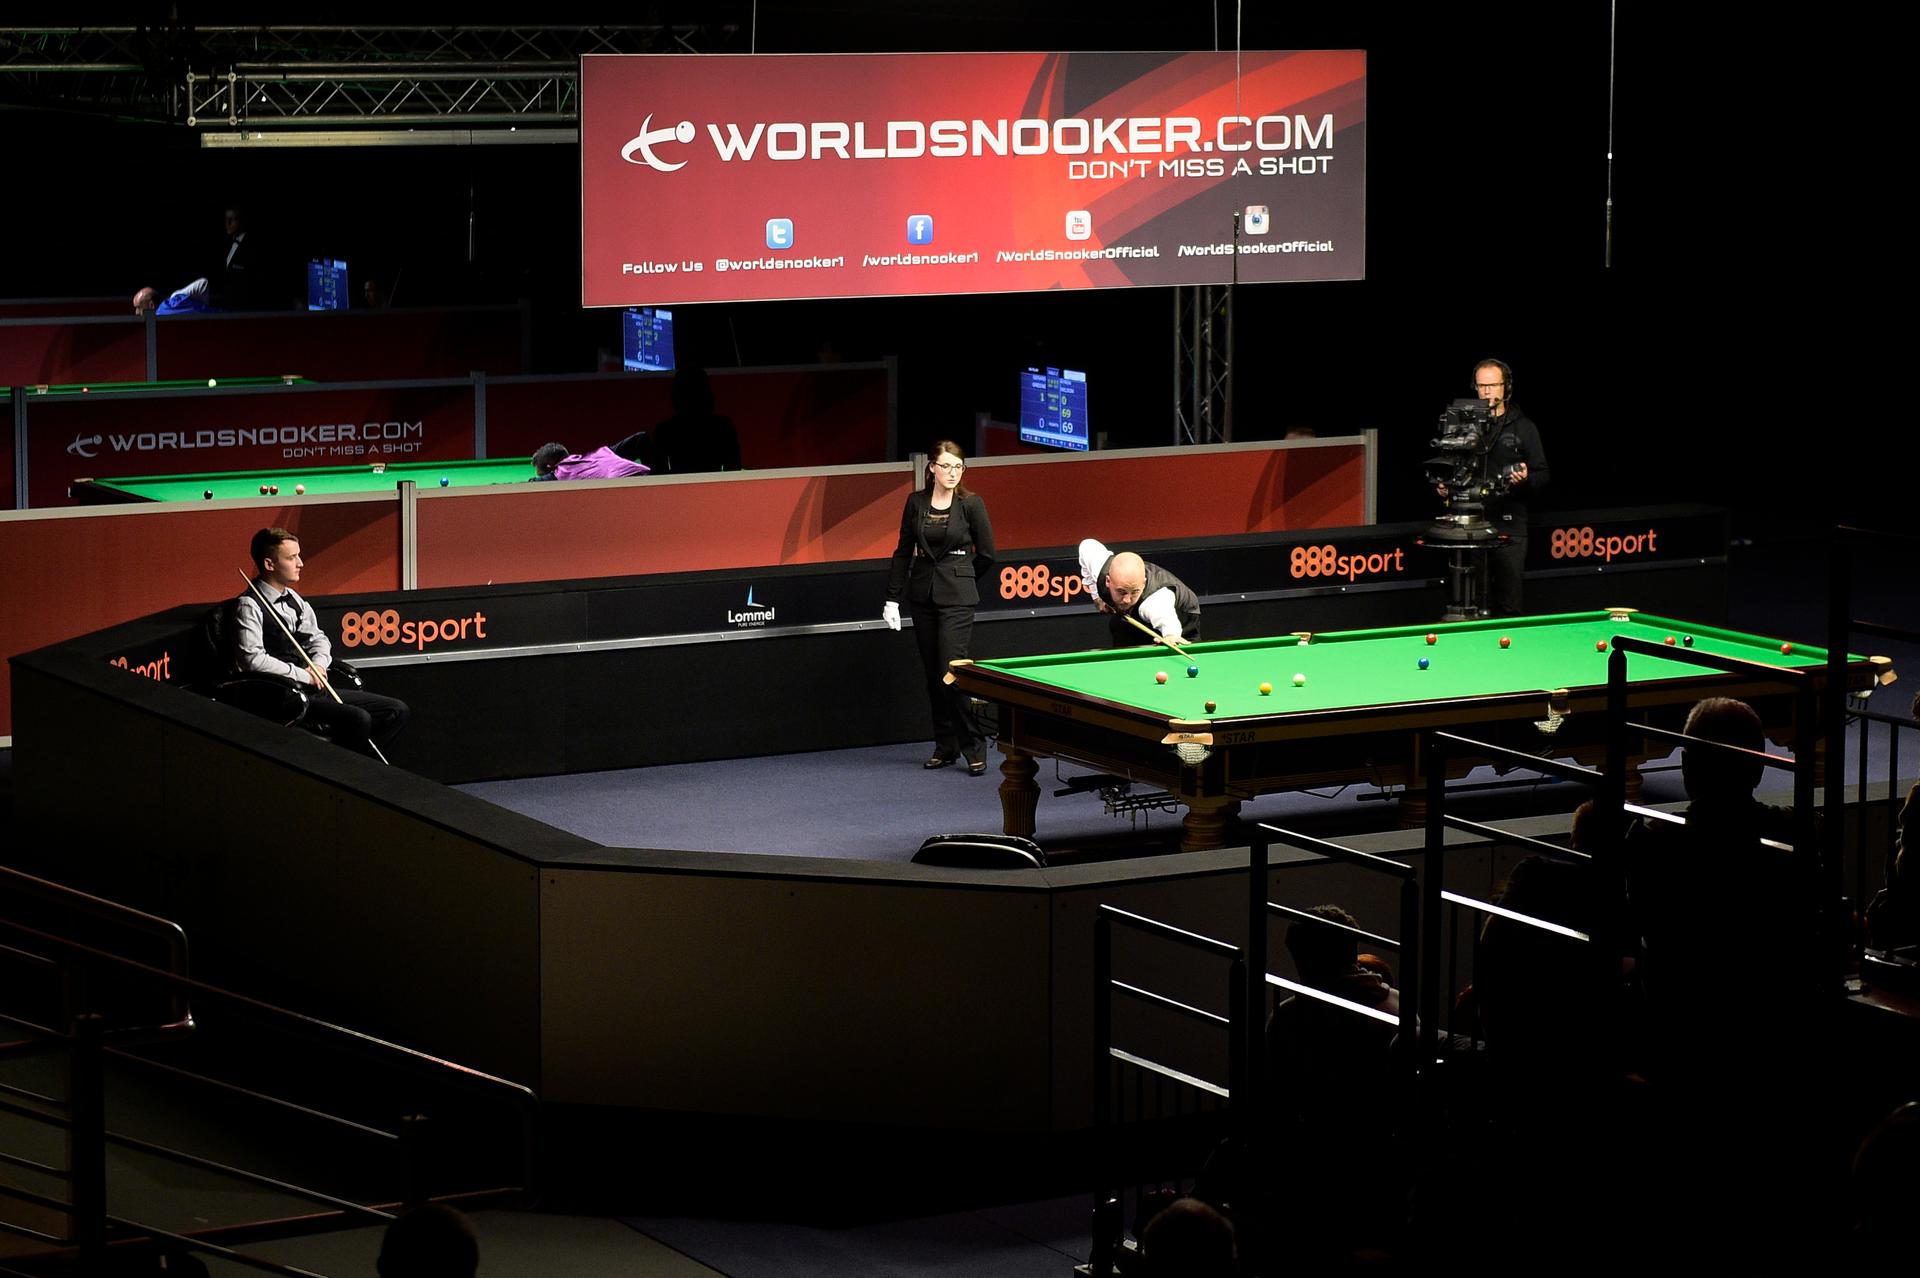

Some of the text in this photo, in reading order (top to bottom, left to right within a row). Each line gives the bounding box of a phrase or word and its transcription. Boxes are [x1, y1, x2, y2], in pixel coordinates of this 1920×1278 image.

[707, 114, 1334, 161] WORLDSNOOKER.COM
[1069, 156, 1334, 180] DON'T MISS A SHOT
[715, 256, 845, 272] @worldsnooker1
[862, 252, 979, 268] /worldsnooker1
[996, 246, 1160, 263] /WorldSnookerOfficial
[622, 261, 704, 275] Follow Us
[108, 421, 423, 451] WORLDSNOOKER.COM
[1062, 422, 1073, 433] 69
[283, 443, 422, 458] DON'T MISS A SHOT
[1551, 527, 1657, 562] 888sport
[1290, 545, 1404, 582] 888sport
[1000, 564, 1092, 603] 888sp
[728, 607, 775, 623] Lommel
[342, 609, 487, 651] 888sport
